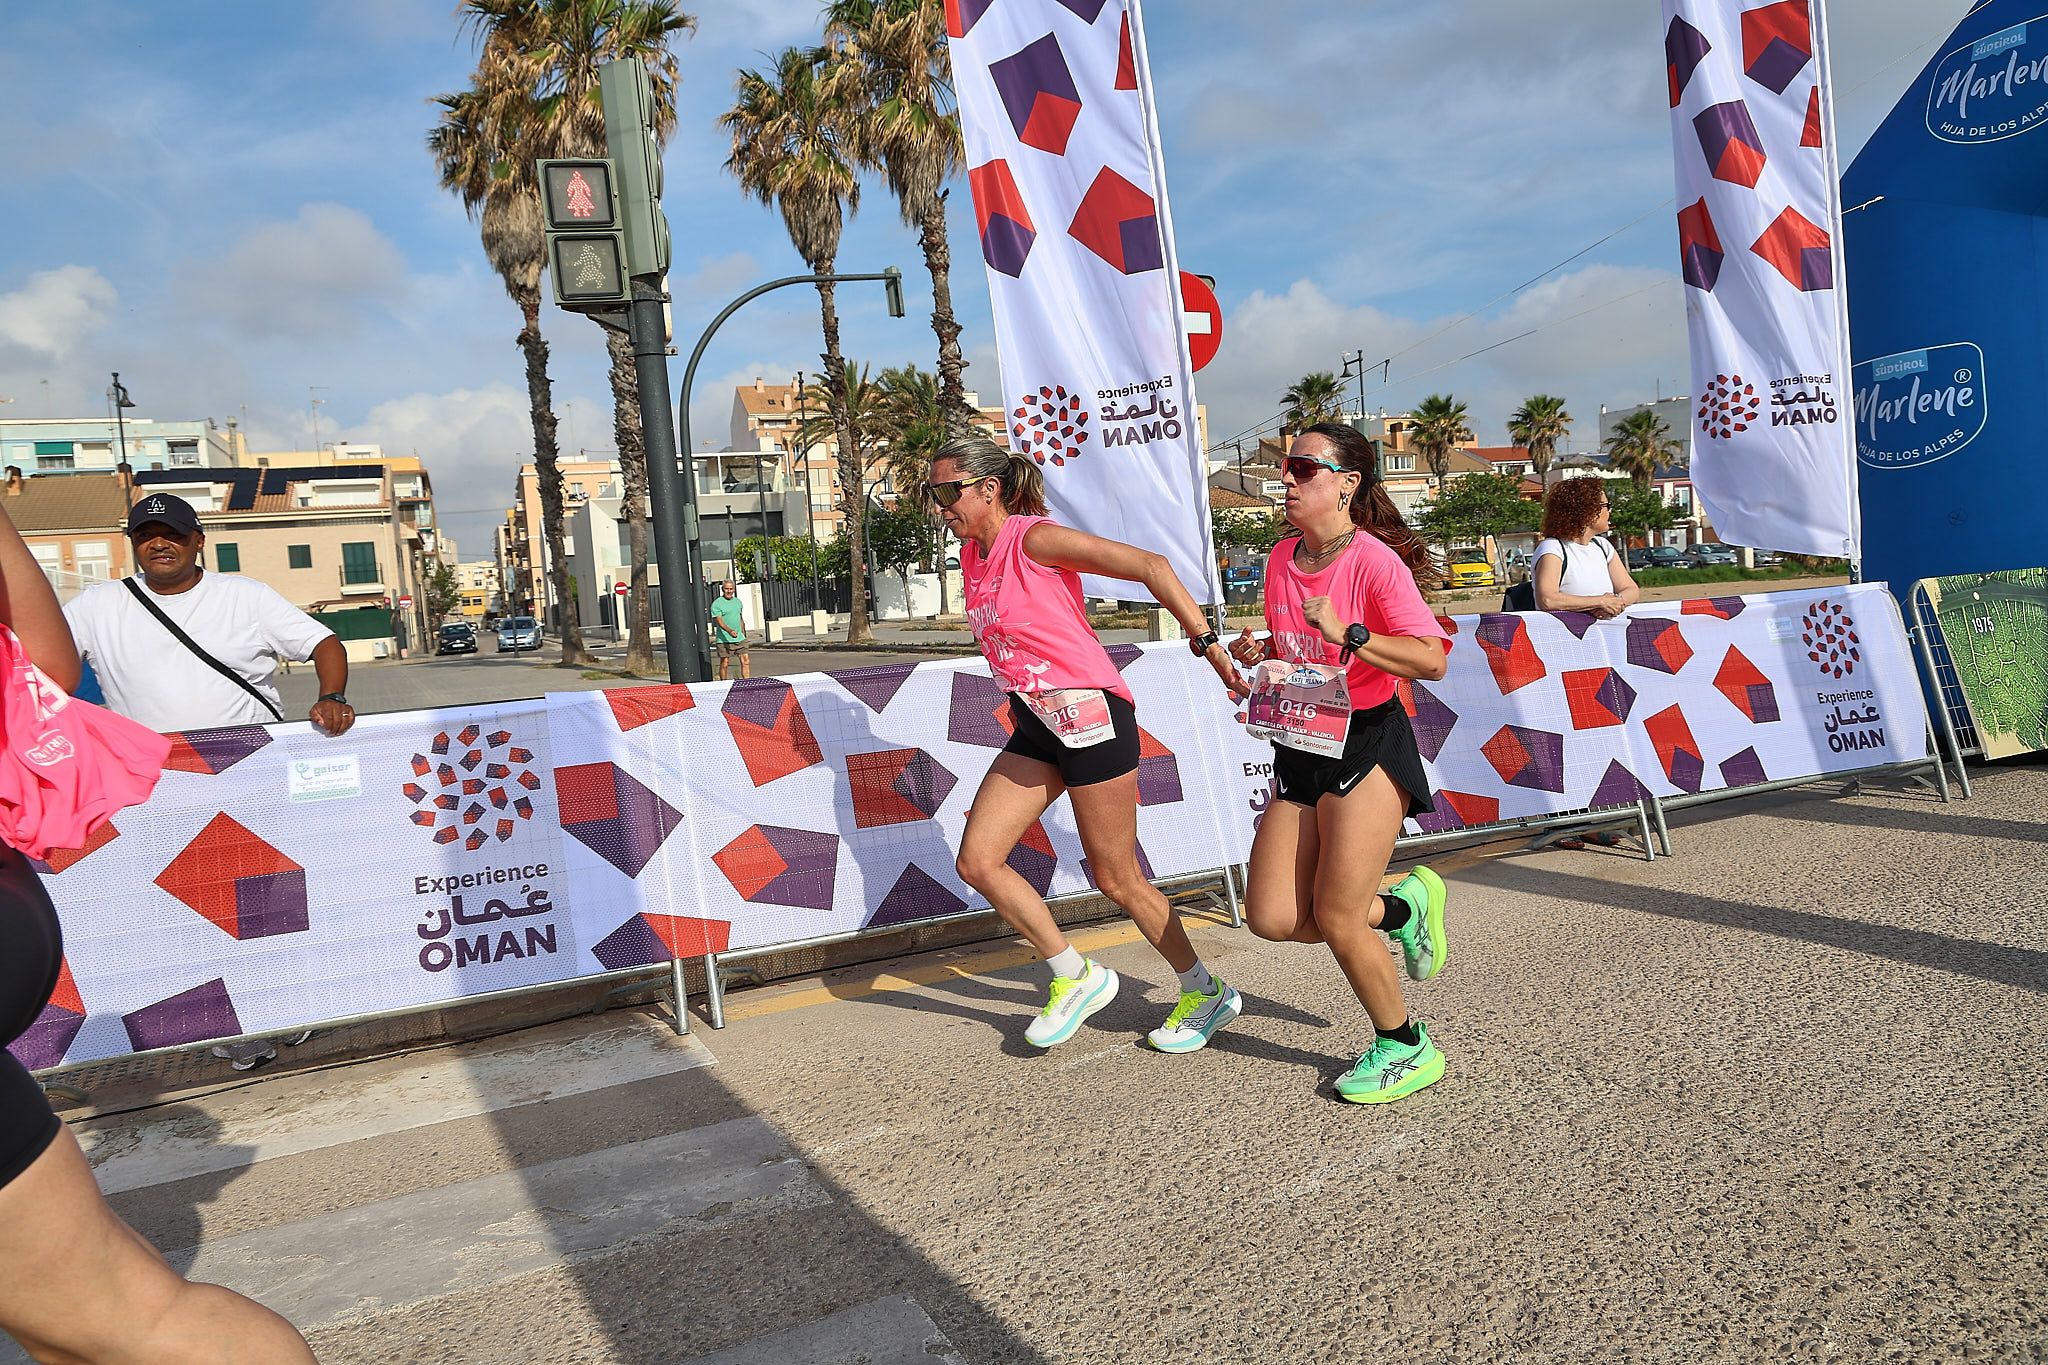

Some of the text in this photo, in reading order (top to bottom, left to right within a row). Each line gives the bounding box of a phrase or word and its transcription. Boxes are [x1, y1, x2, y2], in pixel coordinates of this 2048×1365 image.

[1936, 49, 2048, 119] Marlen
[1940, 121, 1965, 136] HIJA
[1969, 126, 1987, 136] DE
[1991, 119, 2017, 134] LOS
[1858, 428, 1964, 461] HIJA DE LOS ALPES
[1971, 616, 1995, 634] 1975
[1817, 689, 1874, 706] Experience
[1279, 699, 1317, 719] 016
[1256, 720, 1276, 728] CARRERA
[1311, 730, 1335, 740] VALENCIA
[1286, 717, 1305, 727] 3150
[1078, 731, 1105, 743] Santander
[1302, 740, 1333, 751] Santander
[1828, 728, 1886, 753] OMAN
[414, 862, 549, 895] Experience
[418, 923, 557, 973] OMAN
